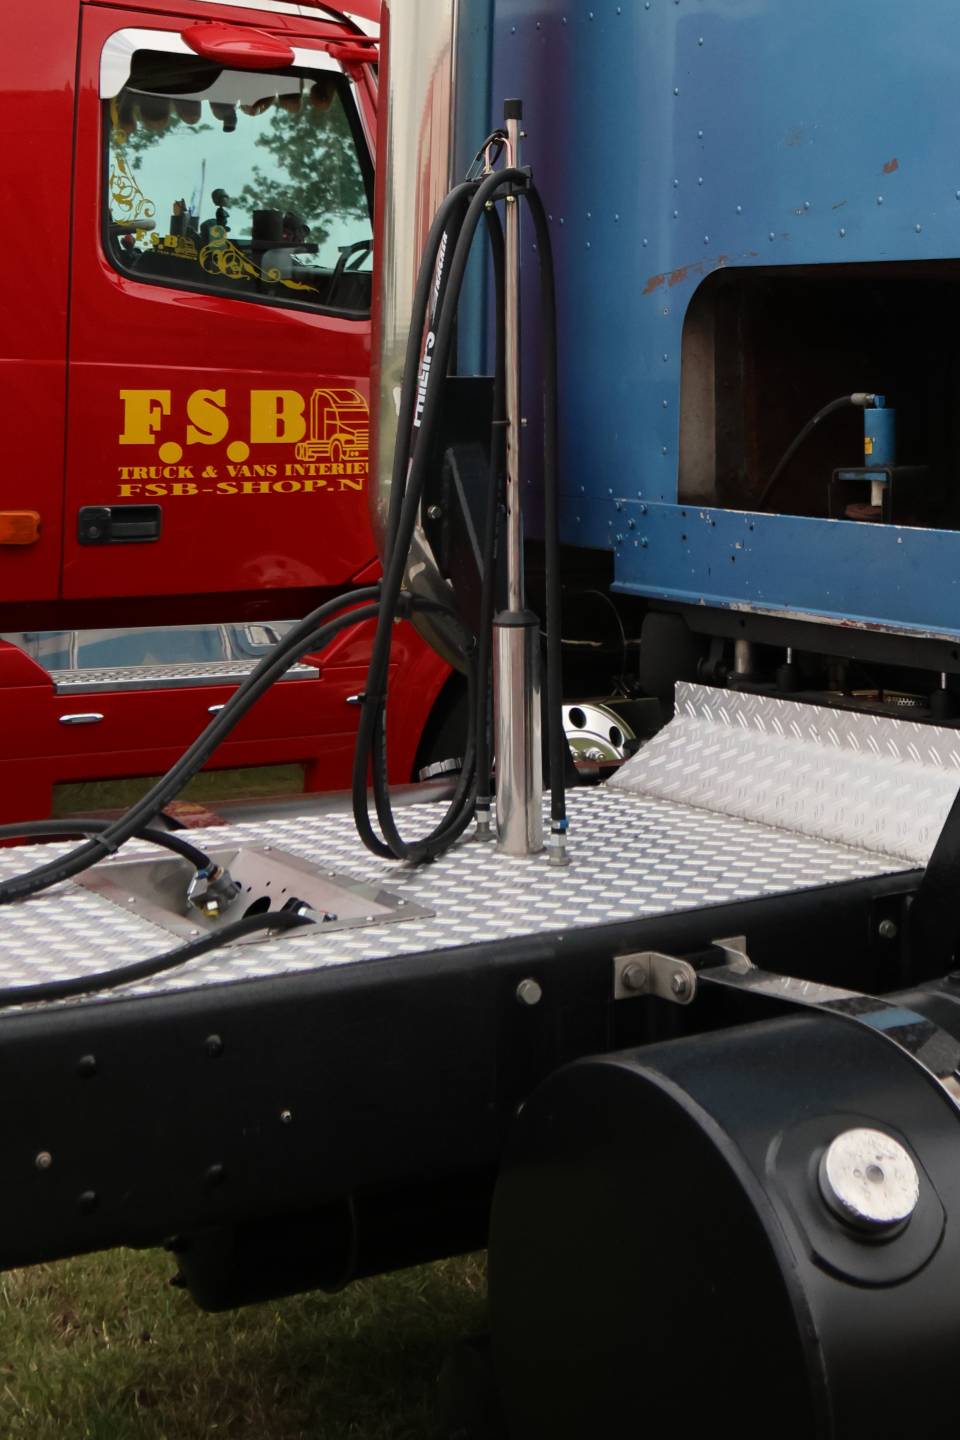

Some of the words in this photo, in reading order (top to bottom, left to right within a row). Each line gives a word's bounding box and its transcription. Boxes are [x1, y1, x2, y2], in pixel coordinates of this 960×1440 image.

[118, 465, 194, 480] TRUCK
[201, 465, 218, 479] &
[226, 463, 278, 478] VANS
[284, 461, 369, 477] INTERIE
